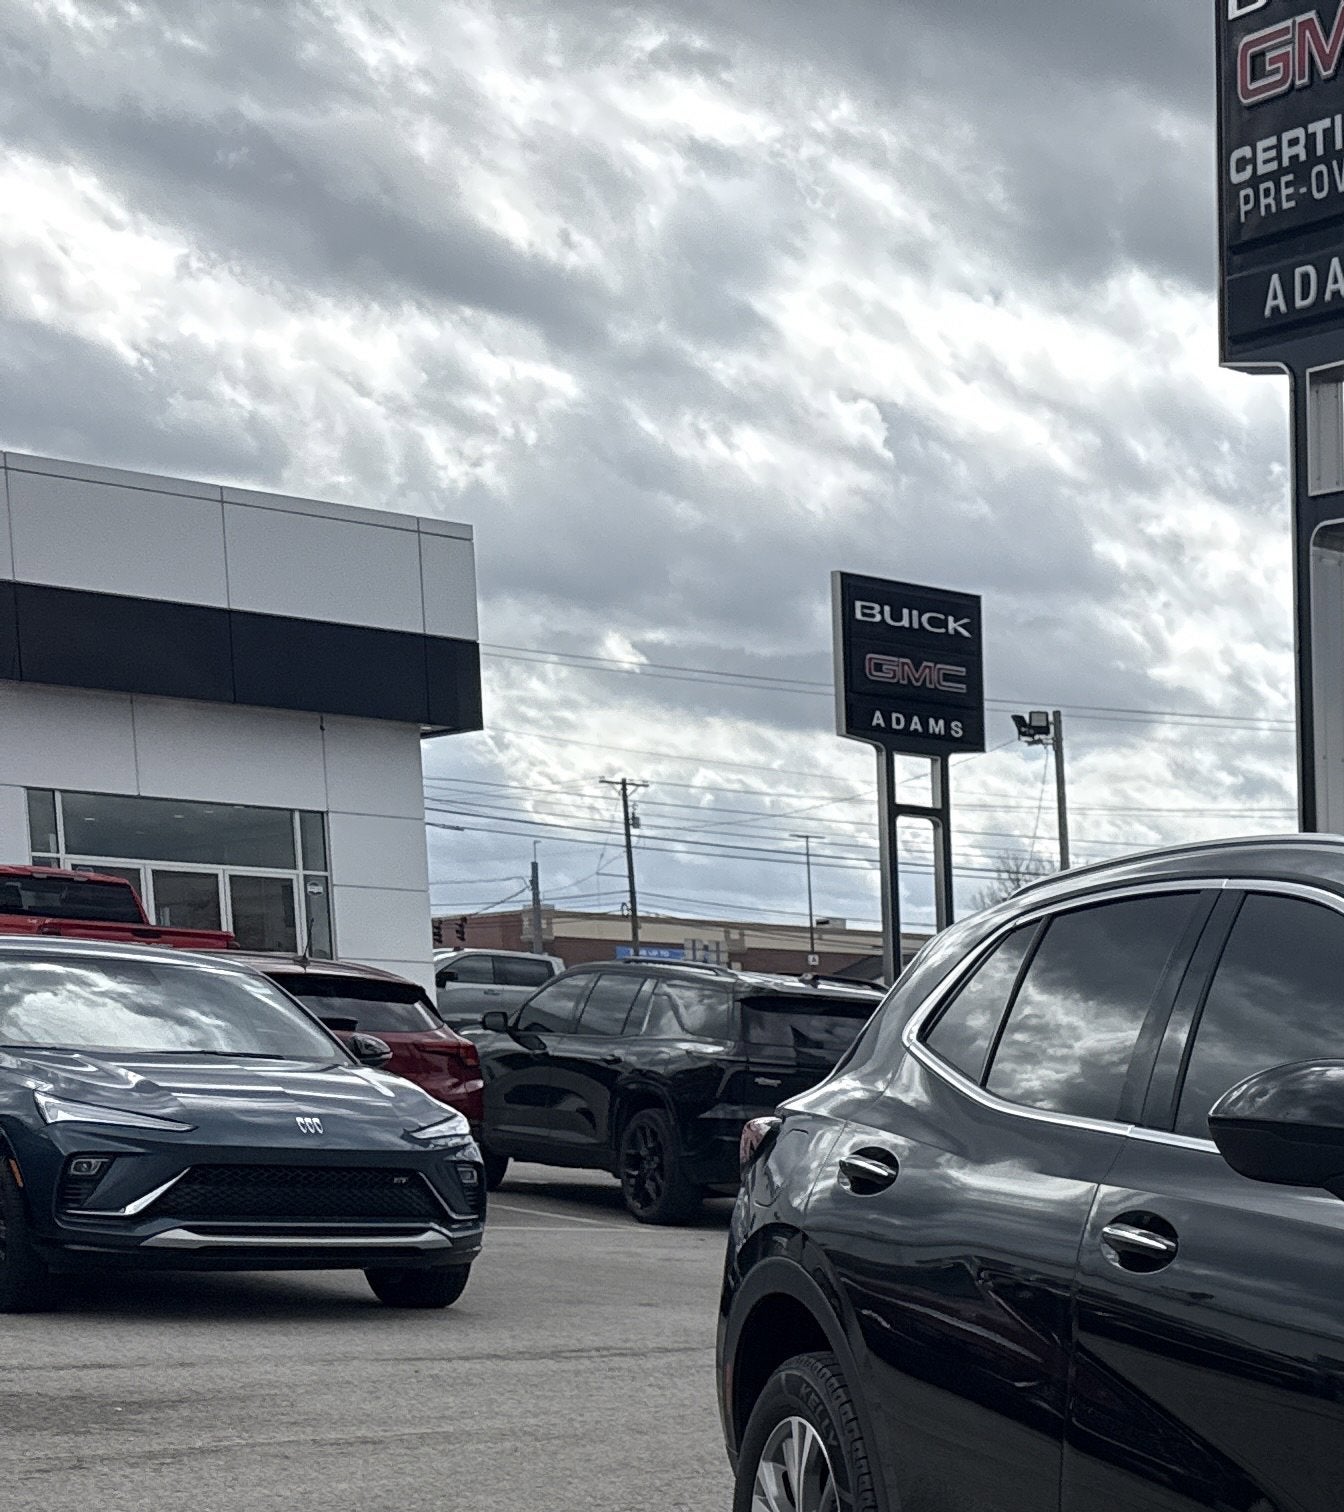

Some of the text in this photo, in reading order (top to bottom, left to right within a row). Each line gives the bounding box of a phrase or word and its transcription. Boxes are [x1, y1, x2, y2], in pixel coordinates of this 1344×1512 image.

[854, 600, 973, 639] BUICK
[865, 653, 967, 694] GMC
[871, 710, 963, 738] ADAMS
